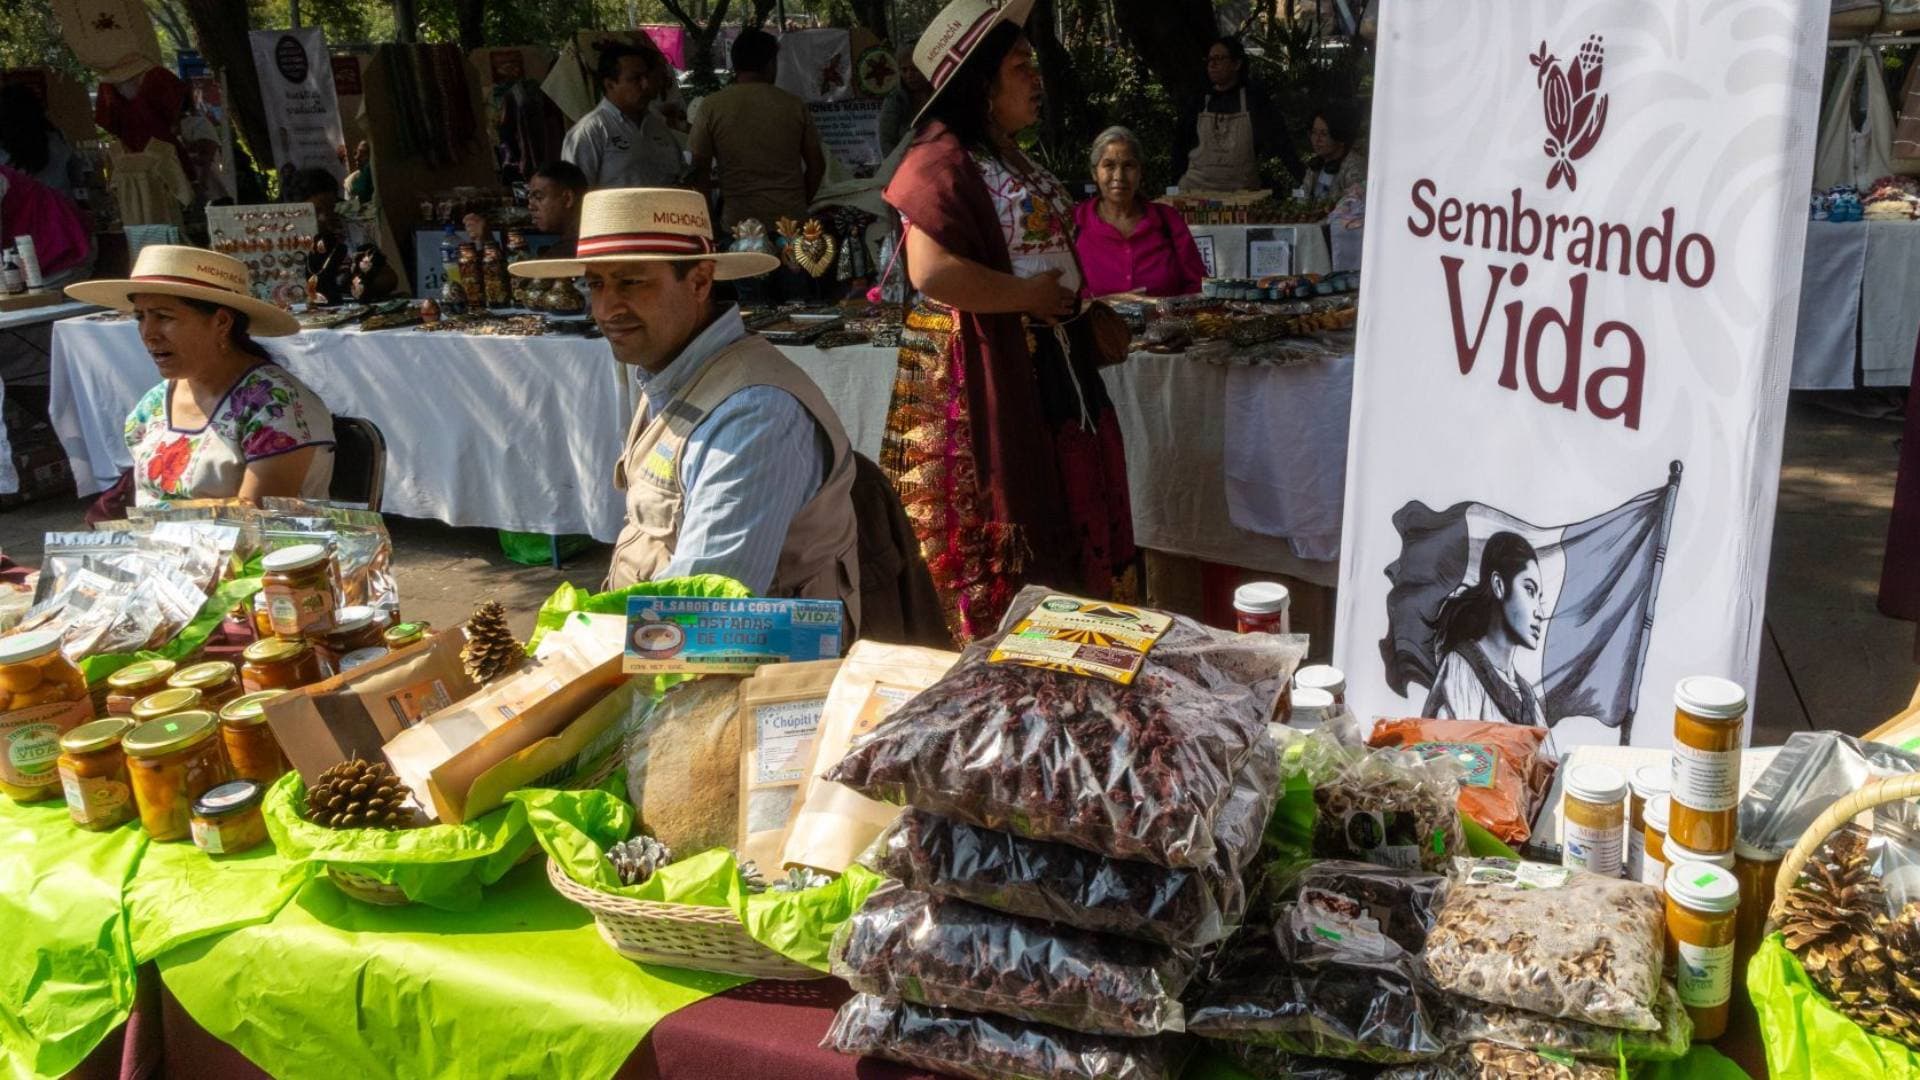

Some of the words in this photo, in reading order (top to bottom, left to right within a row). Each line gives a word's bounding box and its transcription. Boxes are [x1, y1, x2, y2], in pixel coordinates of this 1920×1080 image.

[1407, 178, 1715, 289] Sembrando
[1440, 255, 1646, 431] Vida
[669, 601, 710, 613] SABOR
[712, 601, 728, 613] DE
[730, 602, 745, 613] LA
[748, 602, 787, 614] COSTA
[690, 616, 774, 630] OSTADAS
[796, 612, 837, 622] VIDA
[697, 632, 718, 645] DE
[773, 713, 811, 728] Chúpiti
